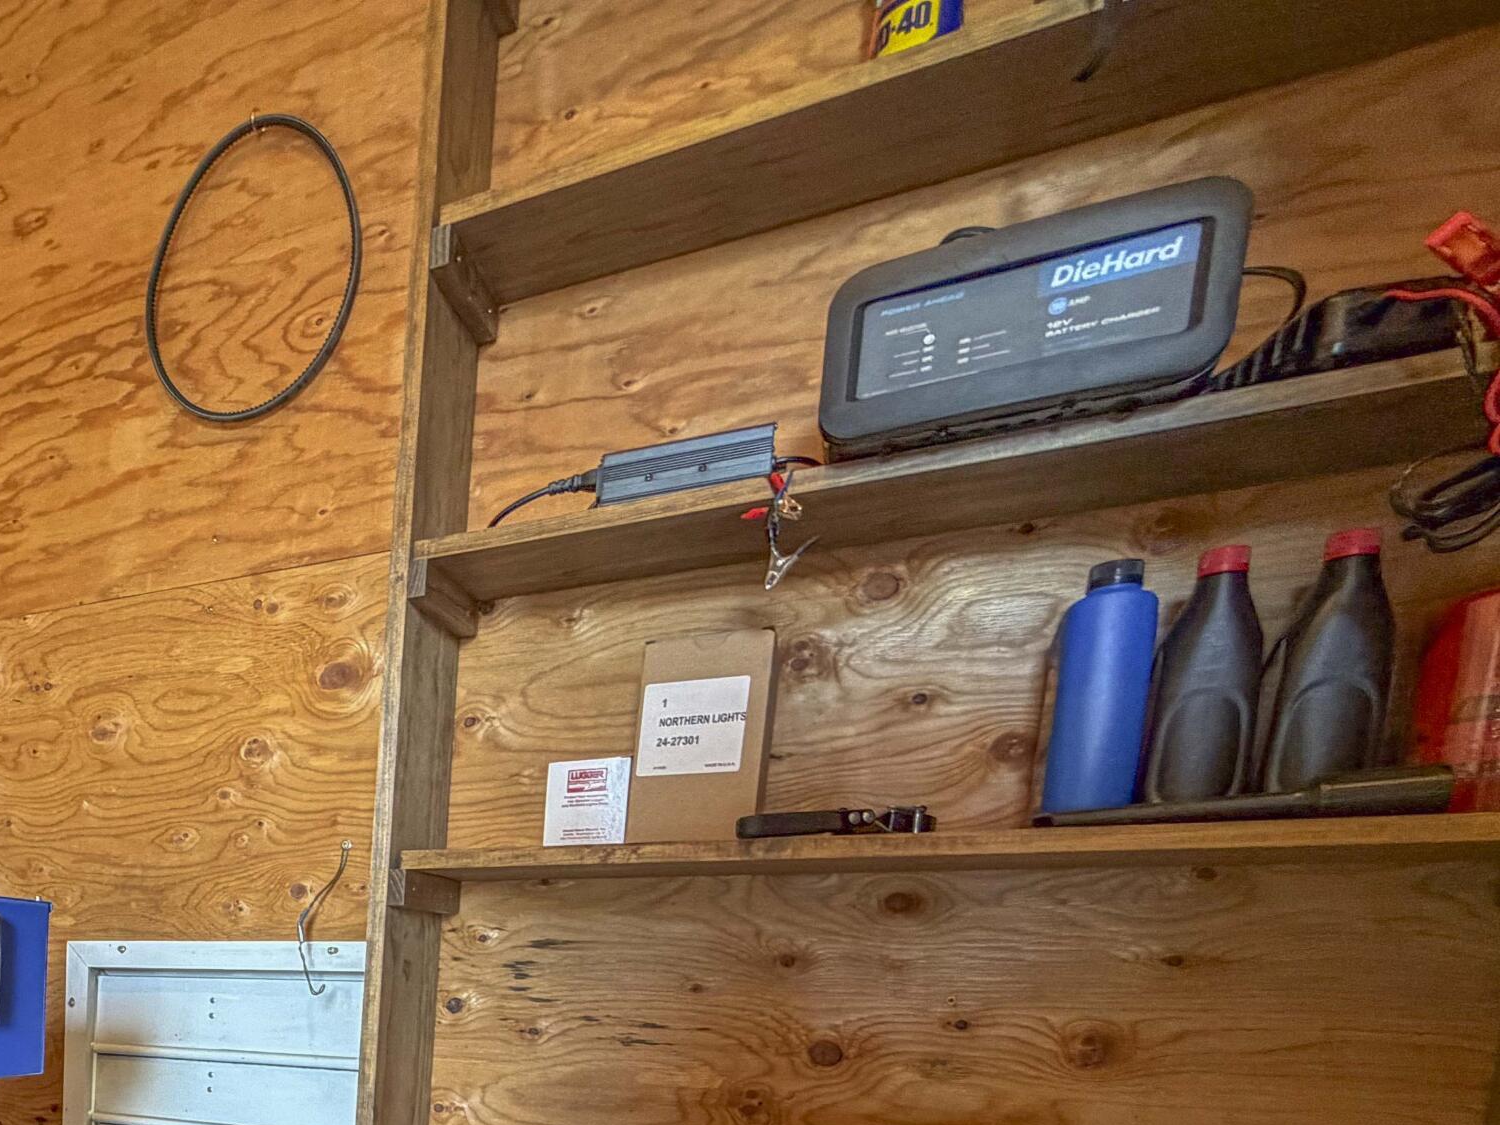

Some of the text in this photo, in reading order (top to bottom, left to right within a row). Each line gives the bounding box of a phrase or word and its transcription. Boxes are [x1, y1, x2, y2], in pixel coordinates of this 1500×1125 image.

[1051, 235, 1184, 288] DieHard
[1045, 306, 1162, 338] BATTERY CHARGER
[661, 698, 668, 708] 1
[658, 711, 748, 728] NORTHERN LIGHTS
[656, 735, 700, 748] 24-27301
[570, 770, 605, 780] LUGGER
